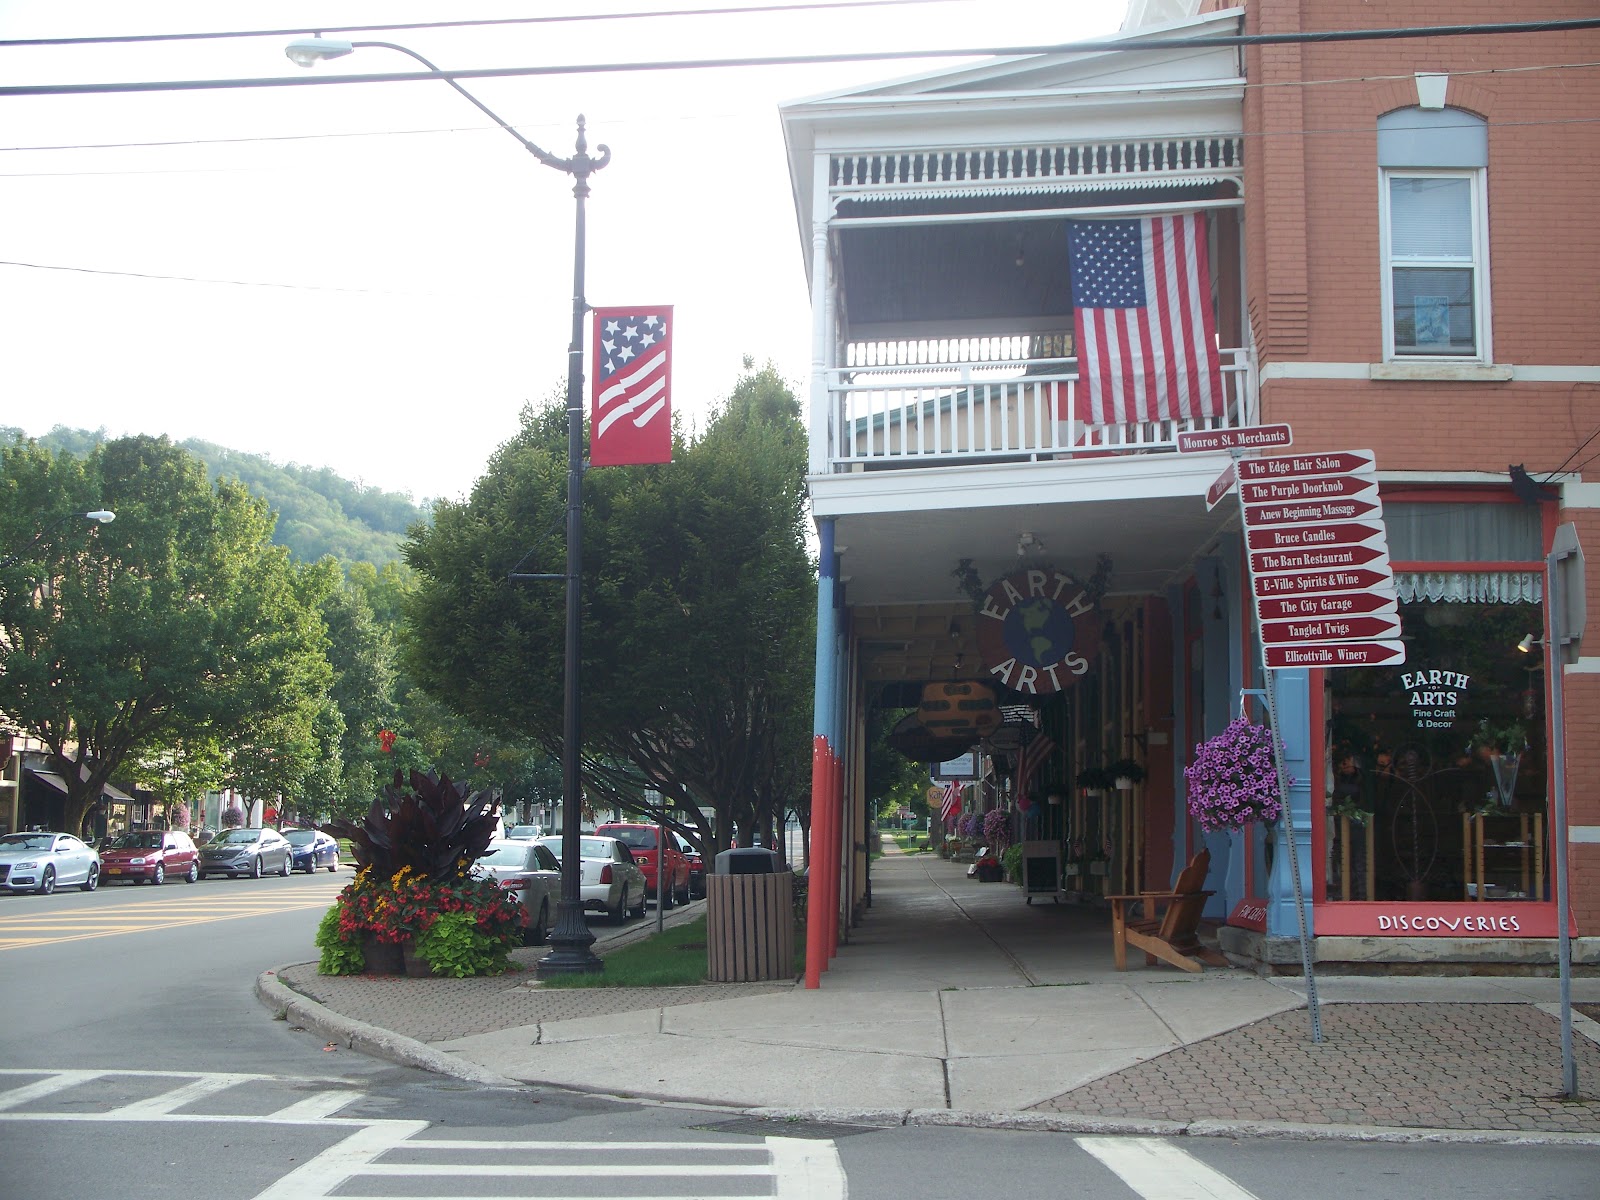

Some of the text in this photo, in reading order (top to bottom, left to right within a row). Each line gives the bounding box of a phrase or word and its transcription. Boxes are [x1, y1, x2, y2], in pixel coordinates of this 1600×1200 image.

[1183, 431, 1285, 449] Monroe St. Merchants
[1249, 458, 1340, 474] The Edge Hair Salon
[1252, 480, 1343, 497] The Purple Doorknob
[1260, 504, 1355, 520] Anew Beginning Massage
[1275, 530, 1335, 544] Bruce Candles
[1263, 551, 1353, 568] The Barn Restaurant
[1264, 573, 1359, 591] E-Ville Spirits & Wine
[980, 570, 1095, 621] EARTH
[1280, 599, 1352, 613] The City Garage
[1288, 622, 1349, 637] Tangled Twigs
[1285, 649, 1368, 662] Ellicottville Winery
[990, 651, 1088, 694] ARTS
[1401, 670, 1470, 690] EARTH
[1409, 692, 1457, 706] ARTS
[1378, 915, 1520, 931] DISCOVERIES
